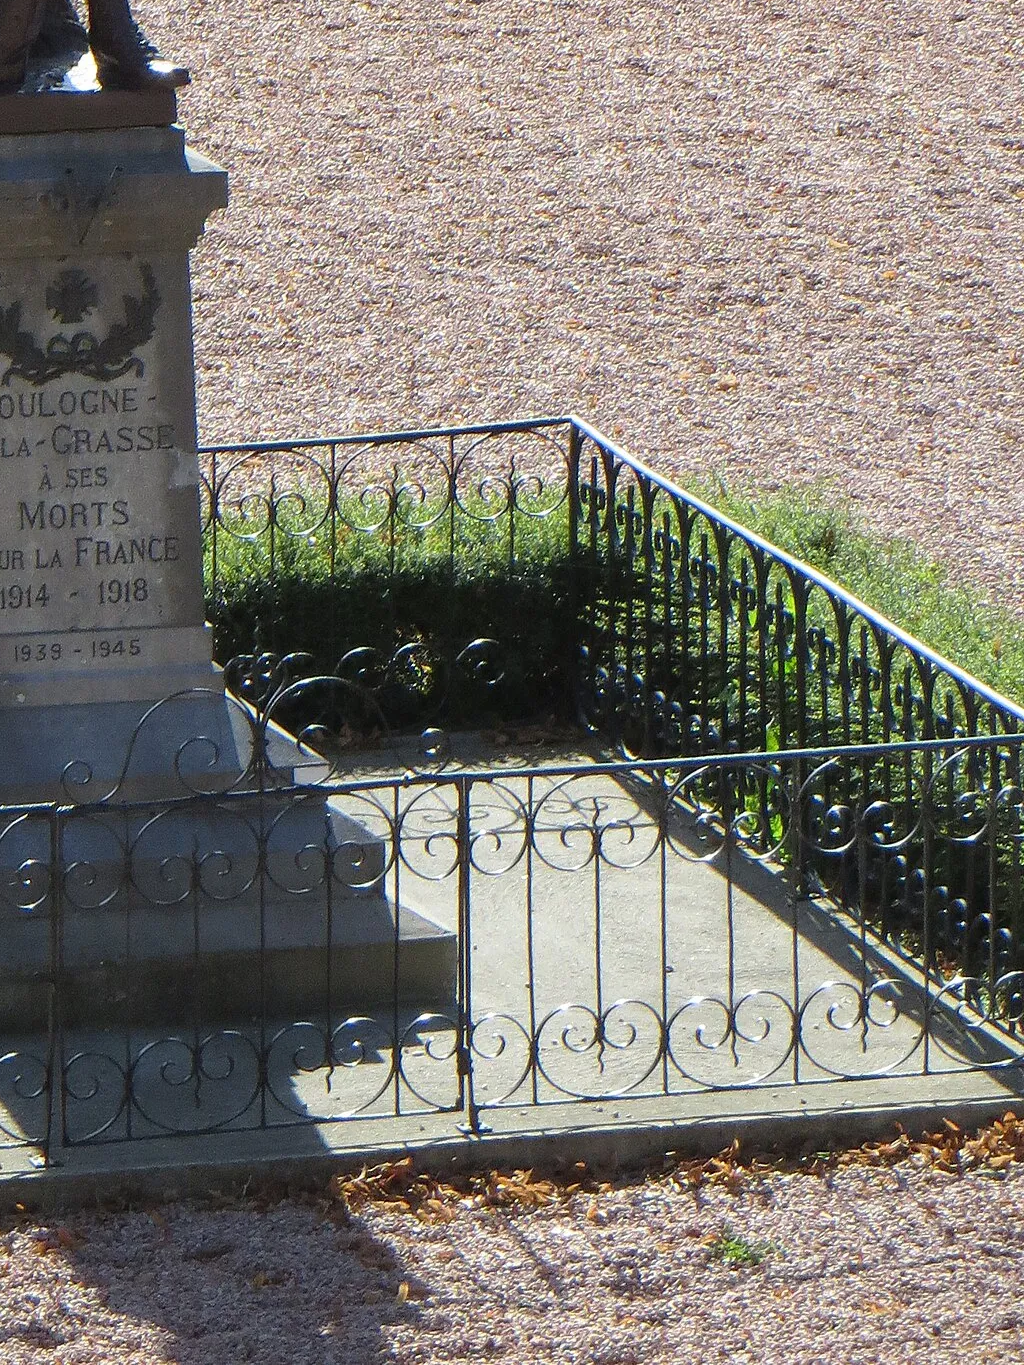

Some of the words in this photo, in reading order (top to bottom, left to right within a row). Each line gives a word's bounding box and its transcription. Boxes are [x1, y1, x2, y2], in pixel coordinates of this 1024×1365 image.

[39, 465, 53, 491] À
[65, 466, 108, 489] SES
[18, 500, 130, 531] MORTS
[36, 549, 63, 570] LA
[74, 536, 180, 567] FRANCE
[0, 583, 51, 610] 1914
[98, 578, 149, 606] 1918
[13, 641, 62, 663] 1939
[91, 639, 142, 659] 1945
